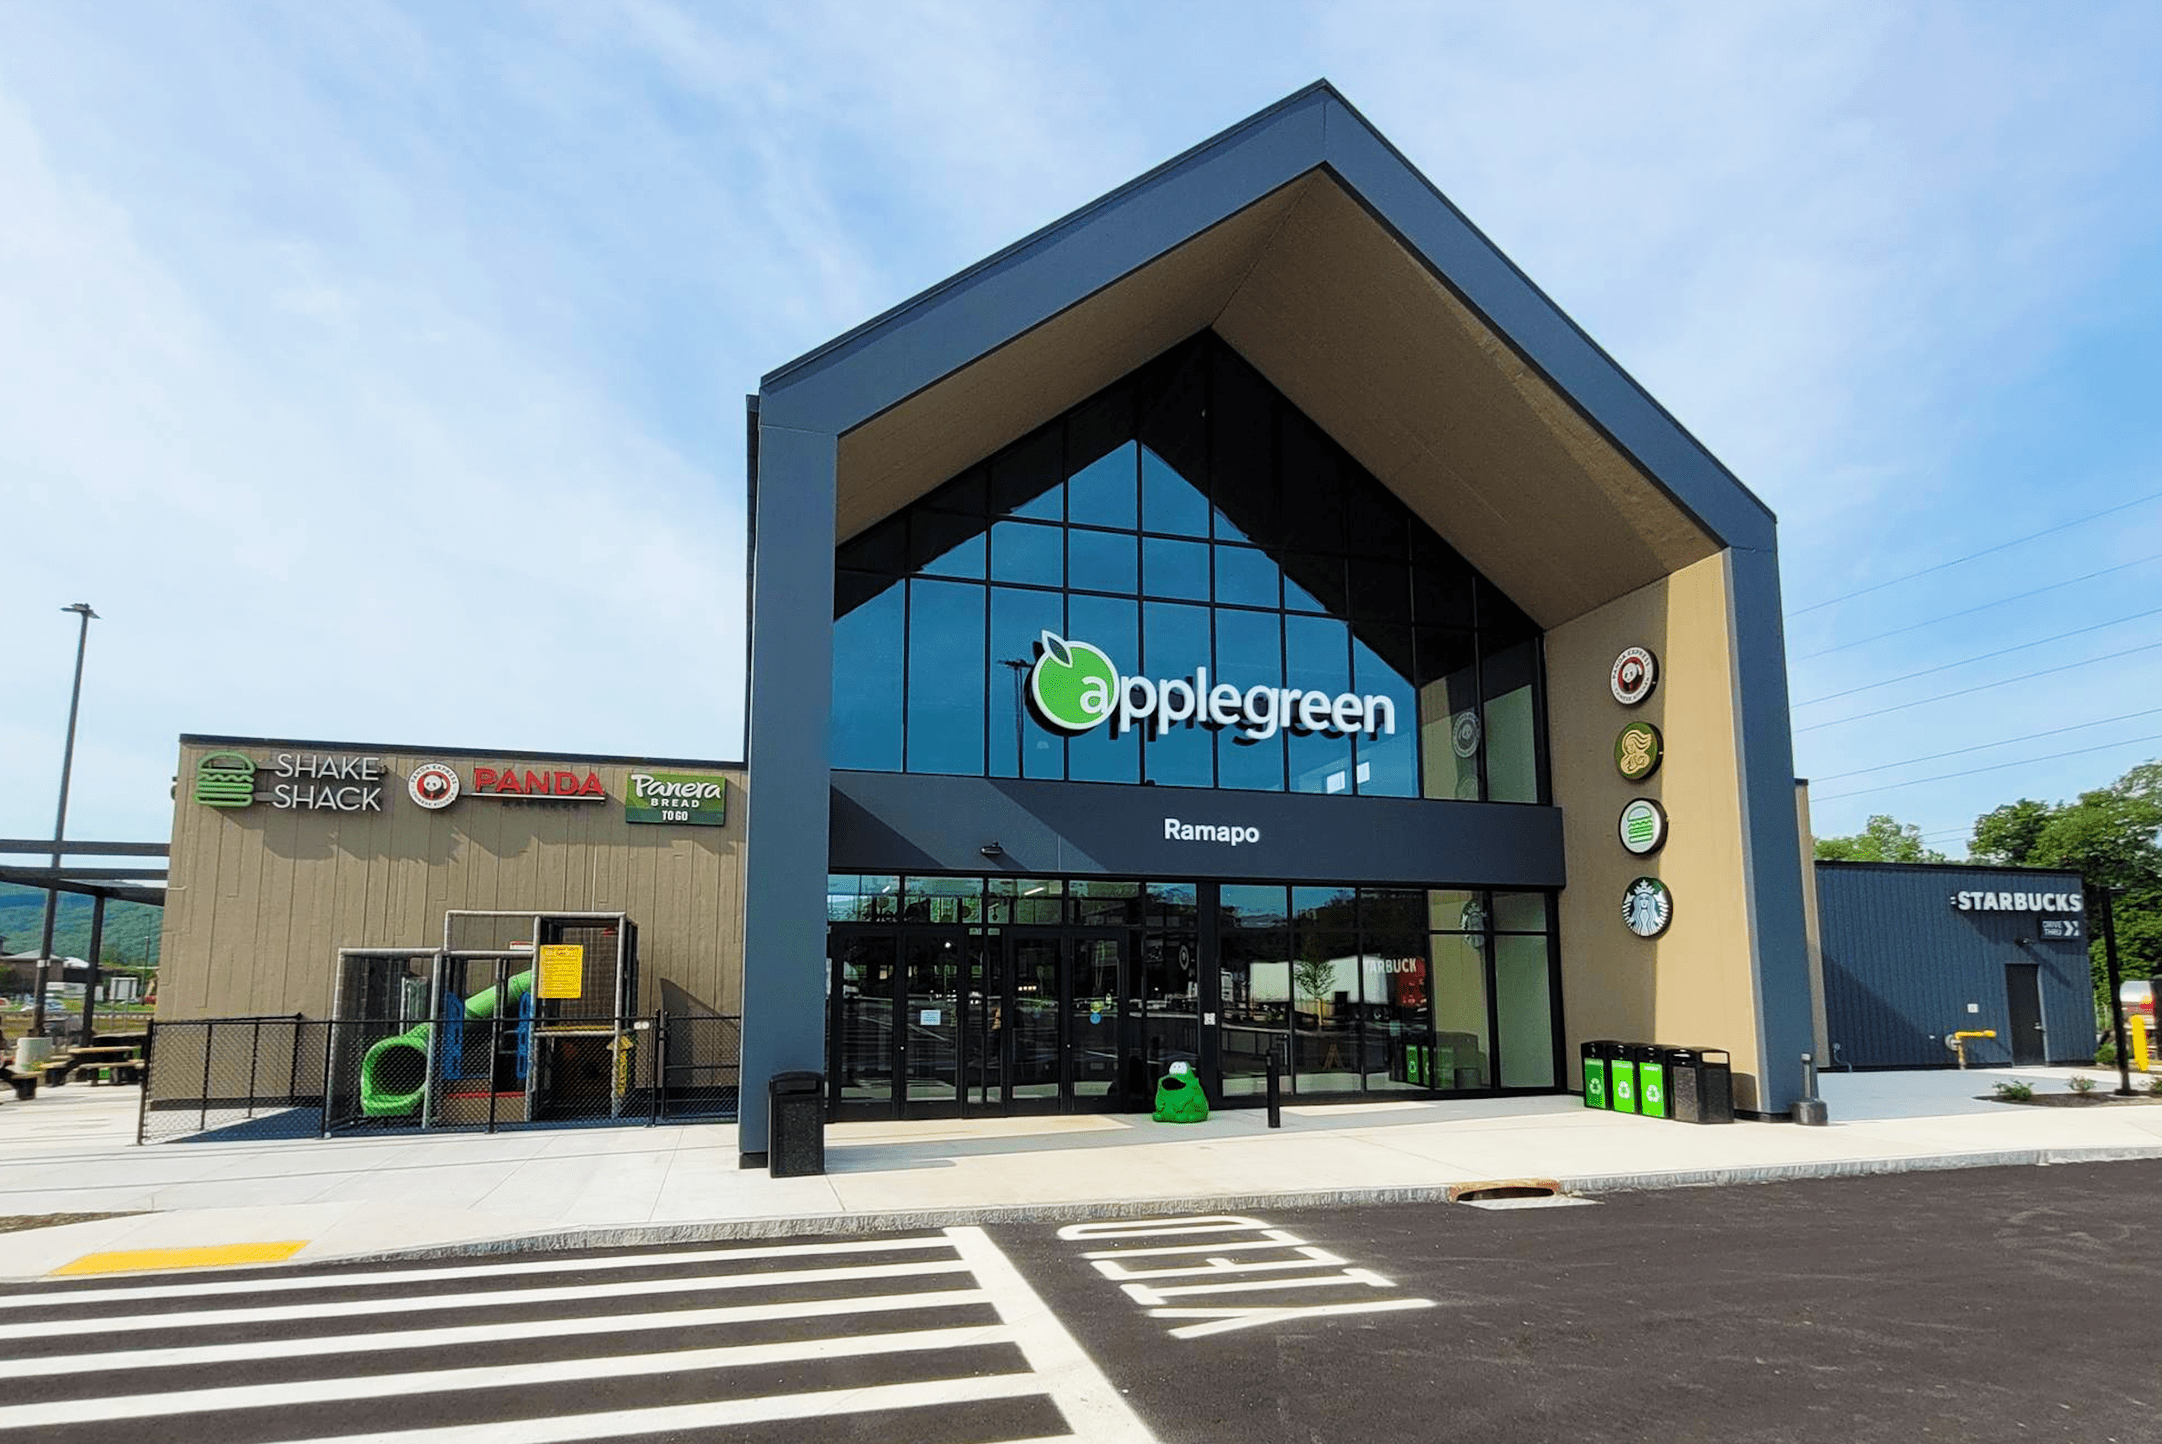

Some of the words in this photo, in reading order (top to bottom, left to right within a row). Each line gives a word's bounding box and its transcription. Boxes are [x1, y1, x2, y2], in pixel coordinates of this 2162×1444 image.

[1613, 655, 1626, 679] PANDA
[1080, 666, 1395, 740] applegreen
[275, 753, 380, 781] SHAKE
[411, 766, 430, 783] PANDA
[433, 765, 458, 784] EXPRESS
[474, 767, 606, 795] PANDA
[631, 774, 721, 799] Panera
[272, 784, 381, 811] SHACK
[651, 798, 700, 808] BREAD
[1164, 818, 1260, 846] Ramapo
[1957, 890, 2083, 912] STARBUCKS
[1056, 1215, 1438, 1340] YIELD
